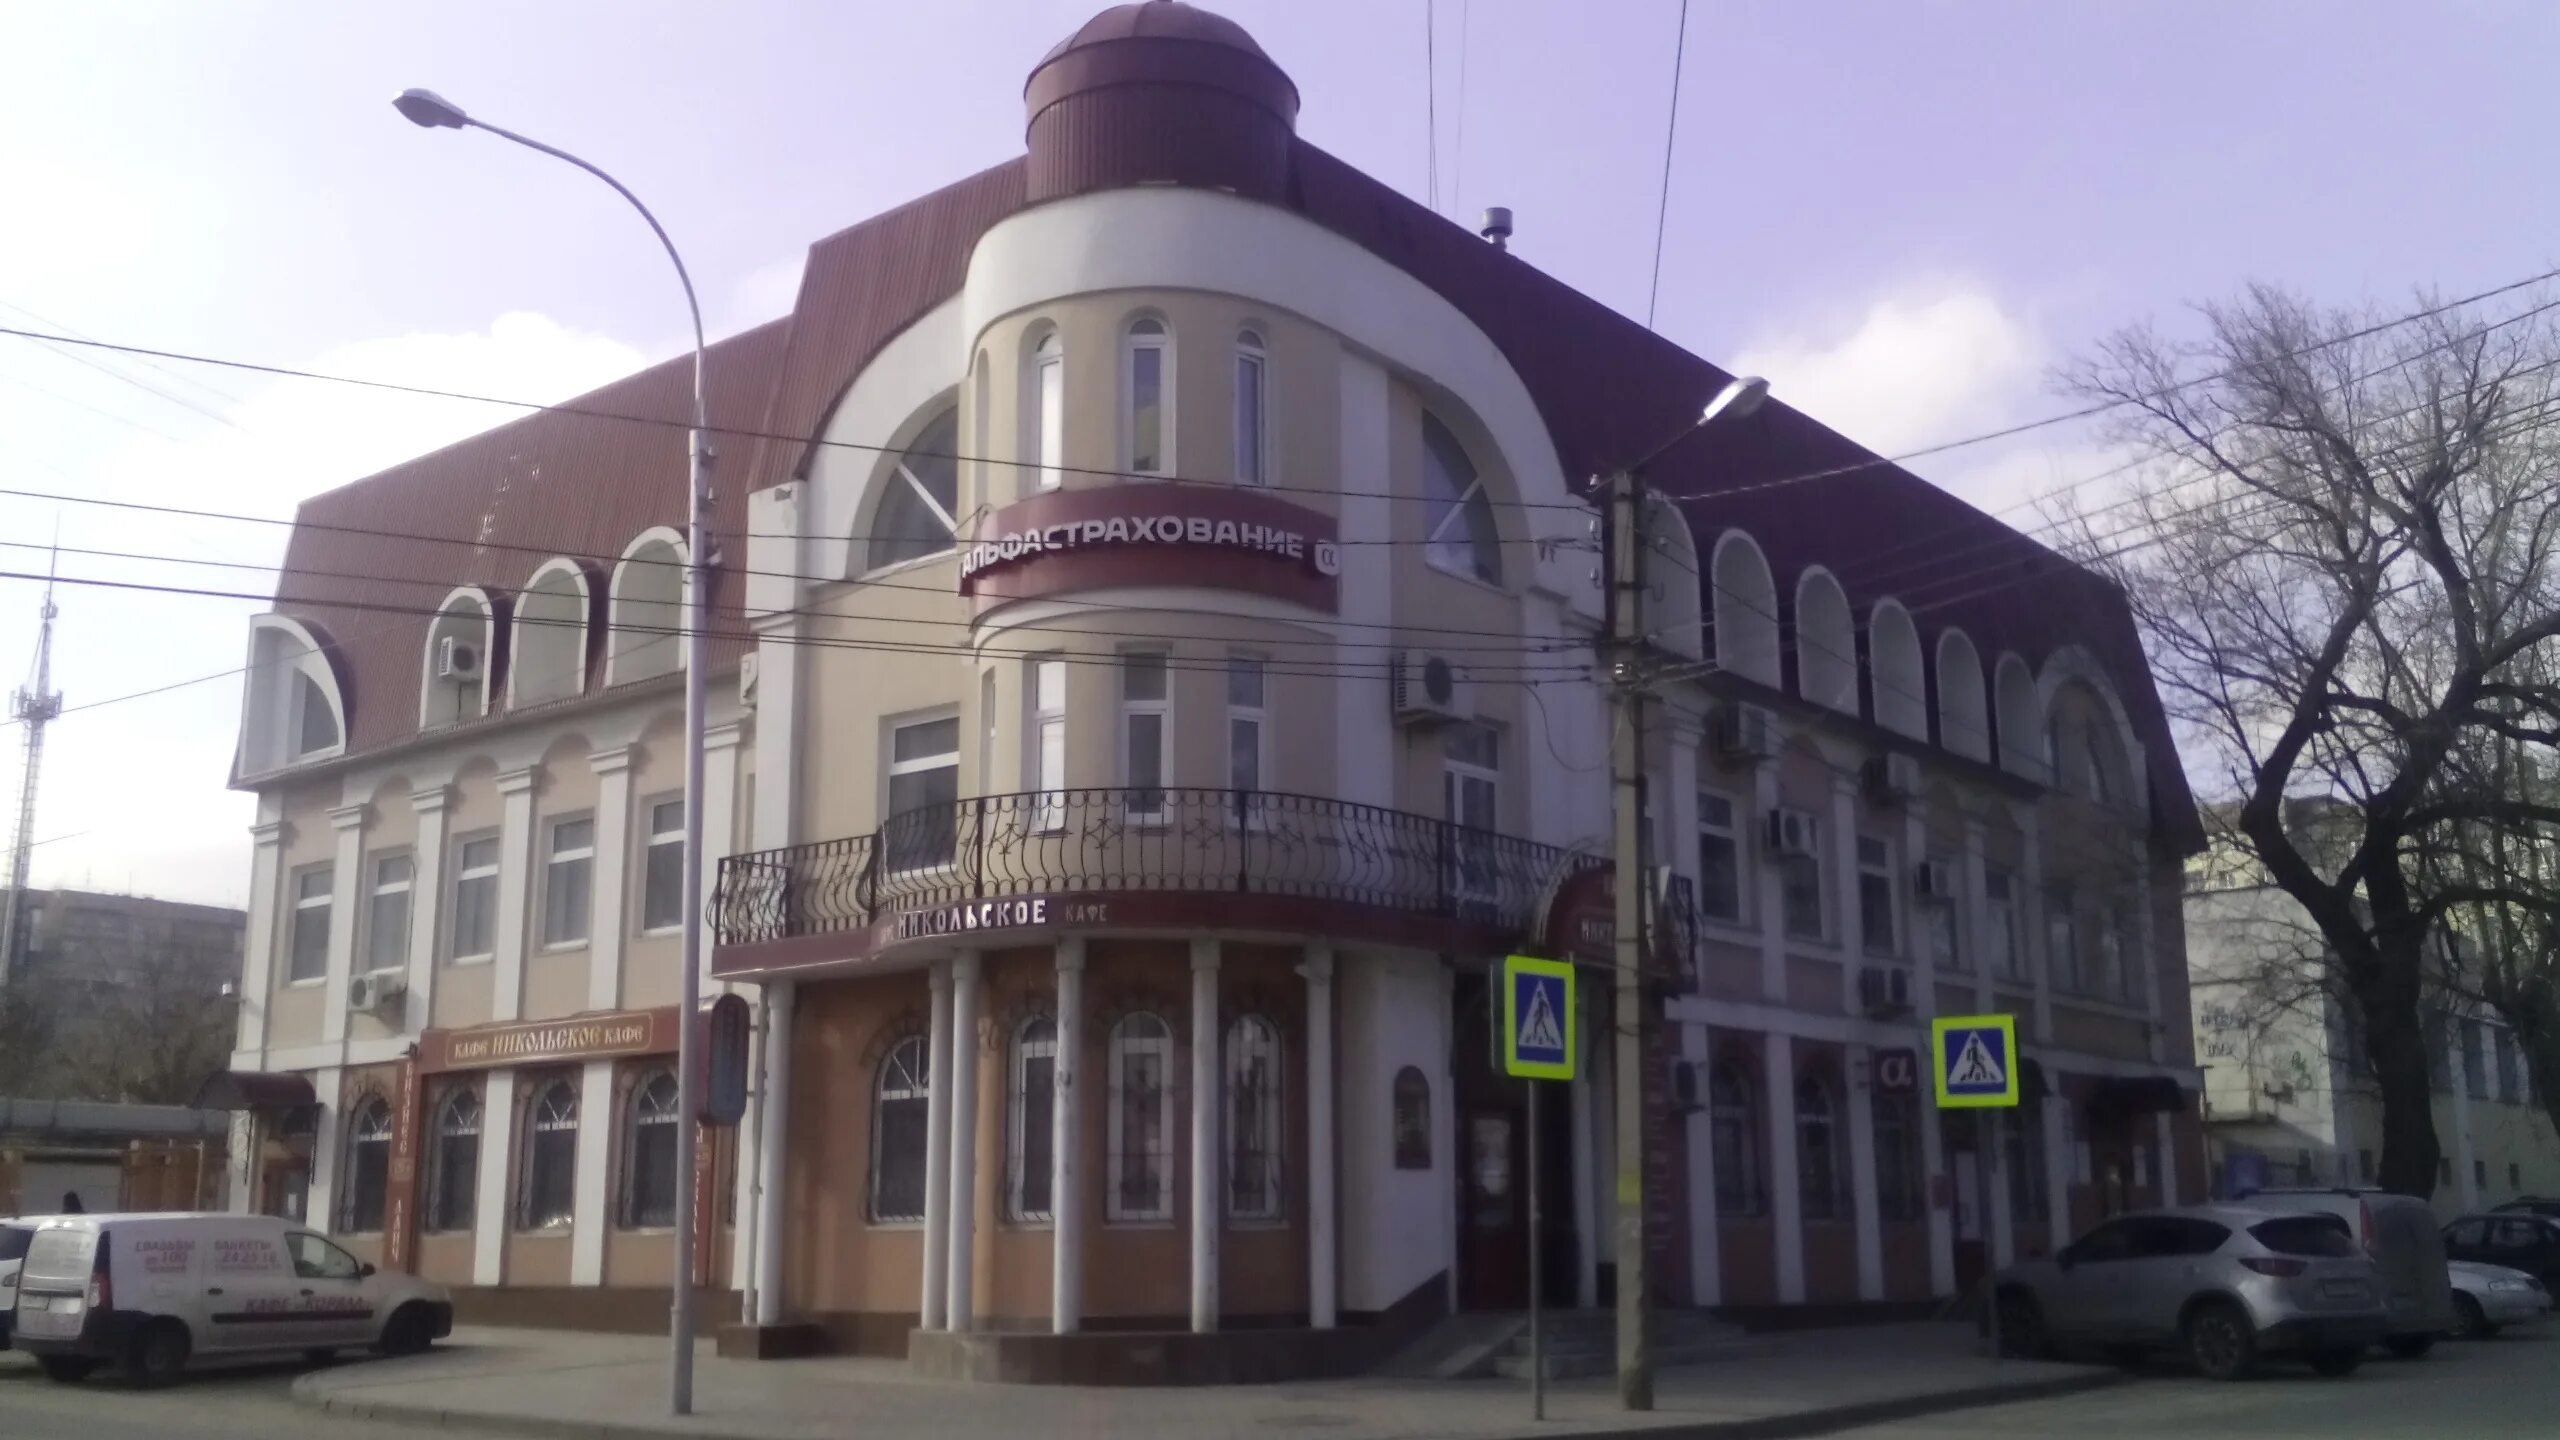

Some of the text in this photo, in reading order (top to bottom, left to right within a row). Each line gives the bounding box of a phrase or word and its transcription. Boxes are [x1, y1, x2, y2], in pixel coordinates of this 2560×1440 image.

[962, 515, 1304, 577] АЛЬФАСТРАХОВАНИЕ
[898, 899, 1047, 938] НИКОЛЬСКОЕ
[1065, 904, 1108, 923] КАФЕ
[454, 1038, 488, 1058] КАФЕ
[604, 1024, 643, 1044] КАФЕ
